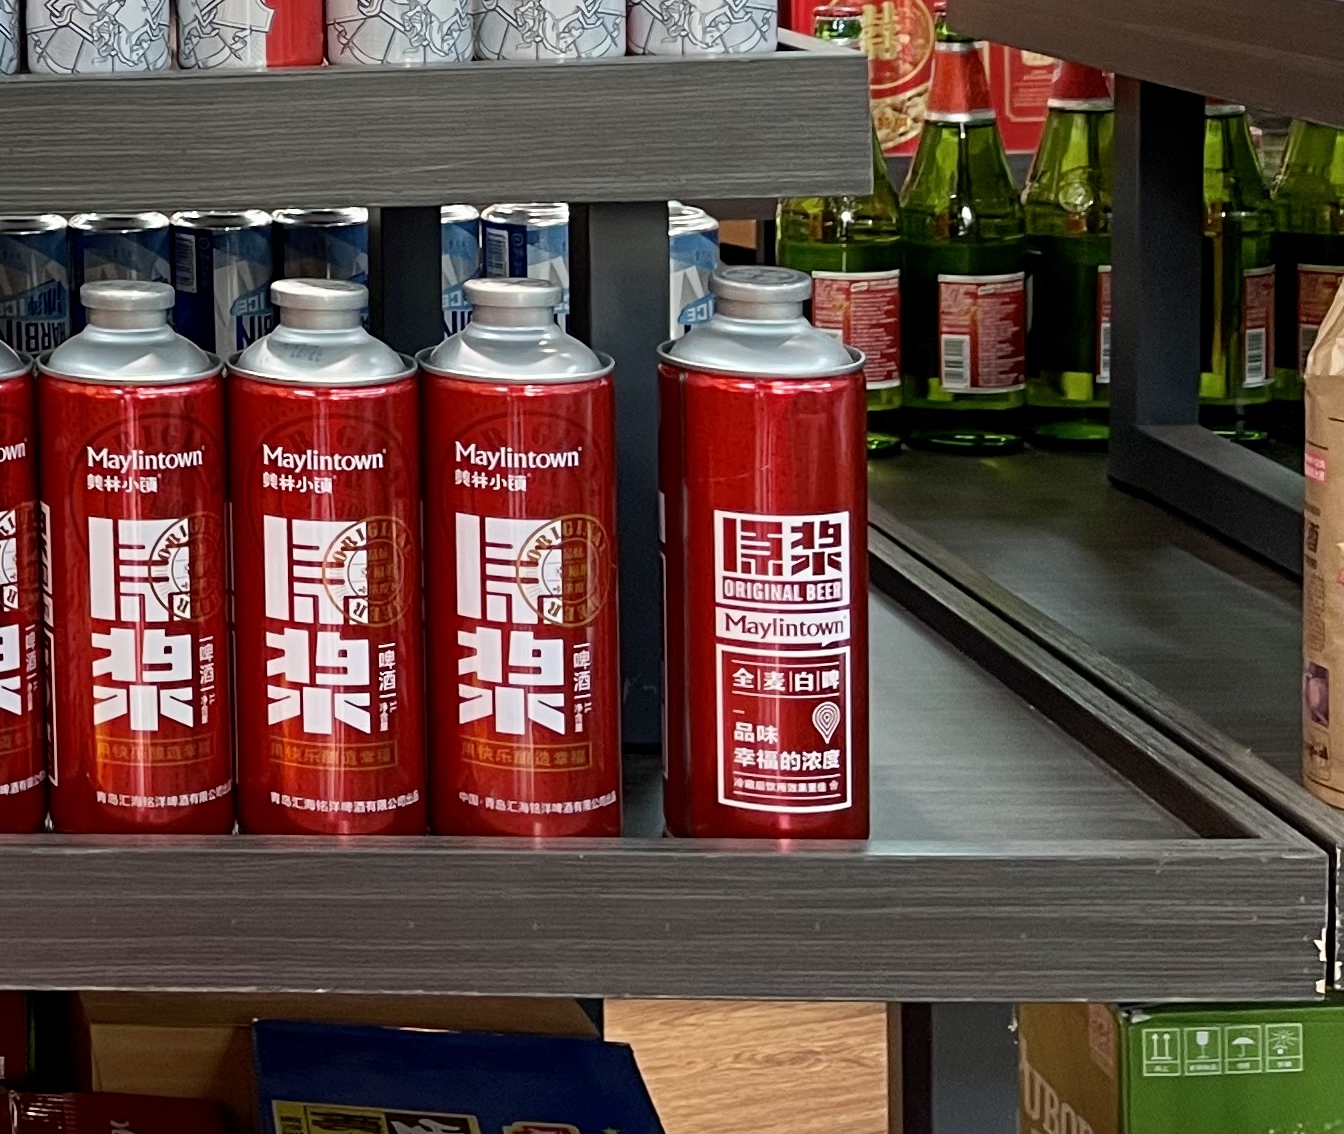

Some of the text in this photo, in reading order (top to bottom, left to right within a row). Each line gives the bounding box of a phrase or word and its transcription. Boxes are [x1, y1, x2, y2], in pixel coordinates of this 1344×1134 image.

[87, 446, 202, 473] Maylintown
[262, 445, 384, 471] Maylintown
[454, 442, 580, 470] Maylintown
[725, 518, 842, 577] 原浆
[724, 579, 841, 602] ORIGINAL BEER
[725, 614, 844, 639] Maylintown
[734, 722, 779, 744] 品味
[734, 748, 840, 771] 幸福的浓度
